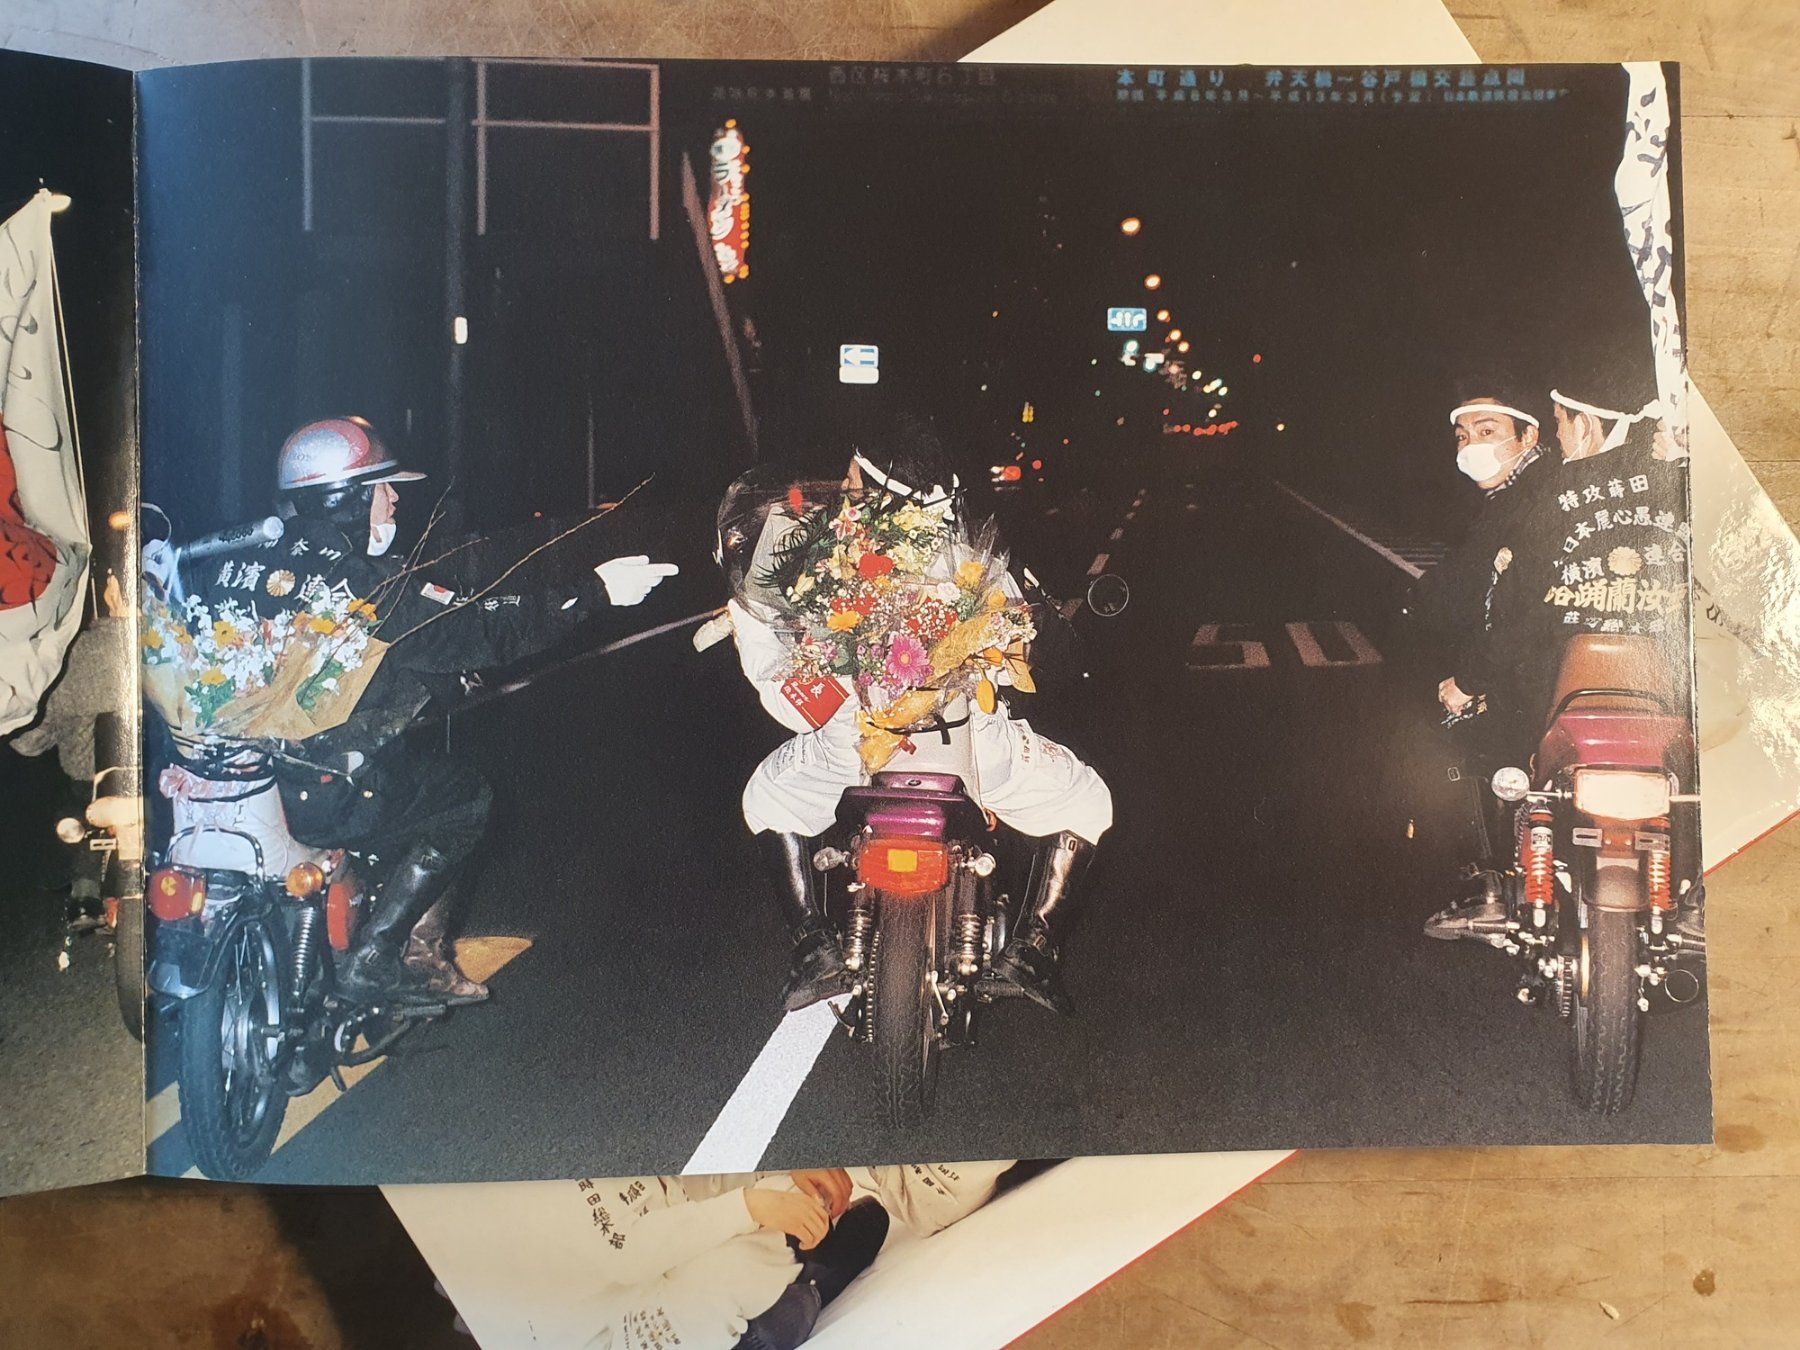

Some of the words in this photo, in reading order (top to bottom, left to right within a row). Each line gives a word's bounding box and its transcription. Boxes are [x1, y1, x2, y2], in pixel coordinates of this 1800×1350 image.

[1116, 69, 1225, 87] 本町通り
[1185, 620, 1383, 669] 50
